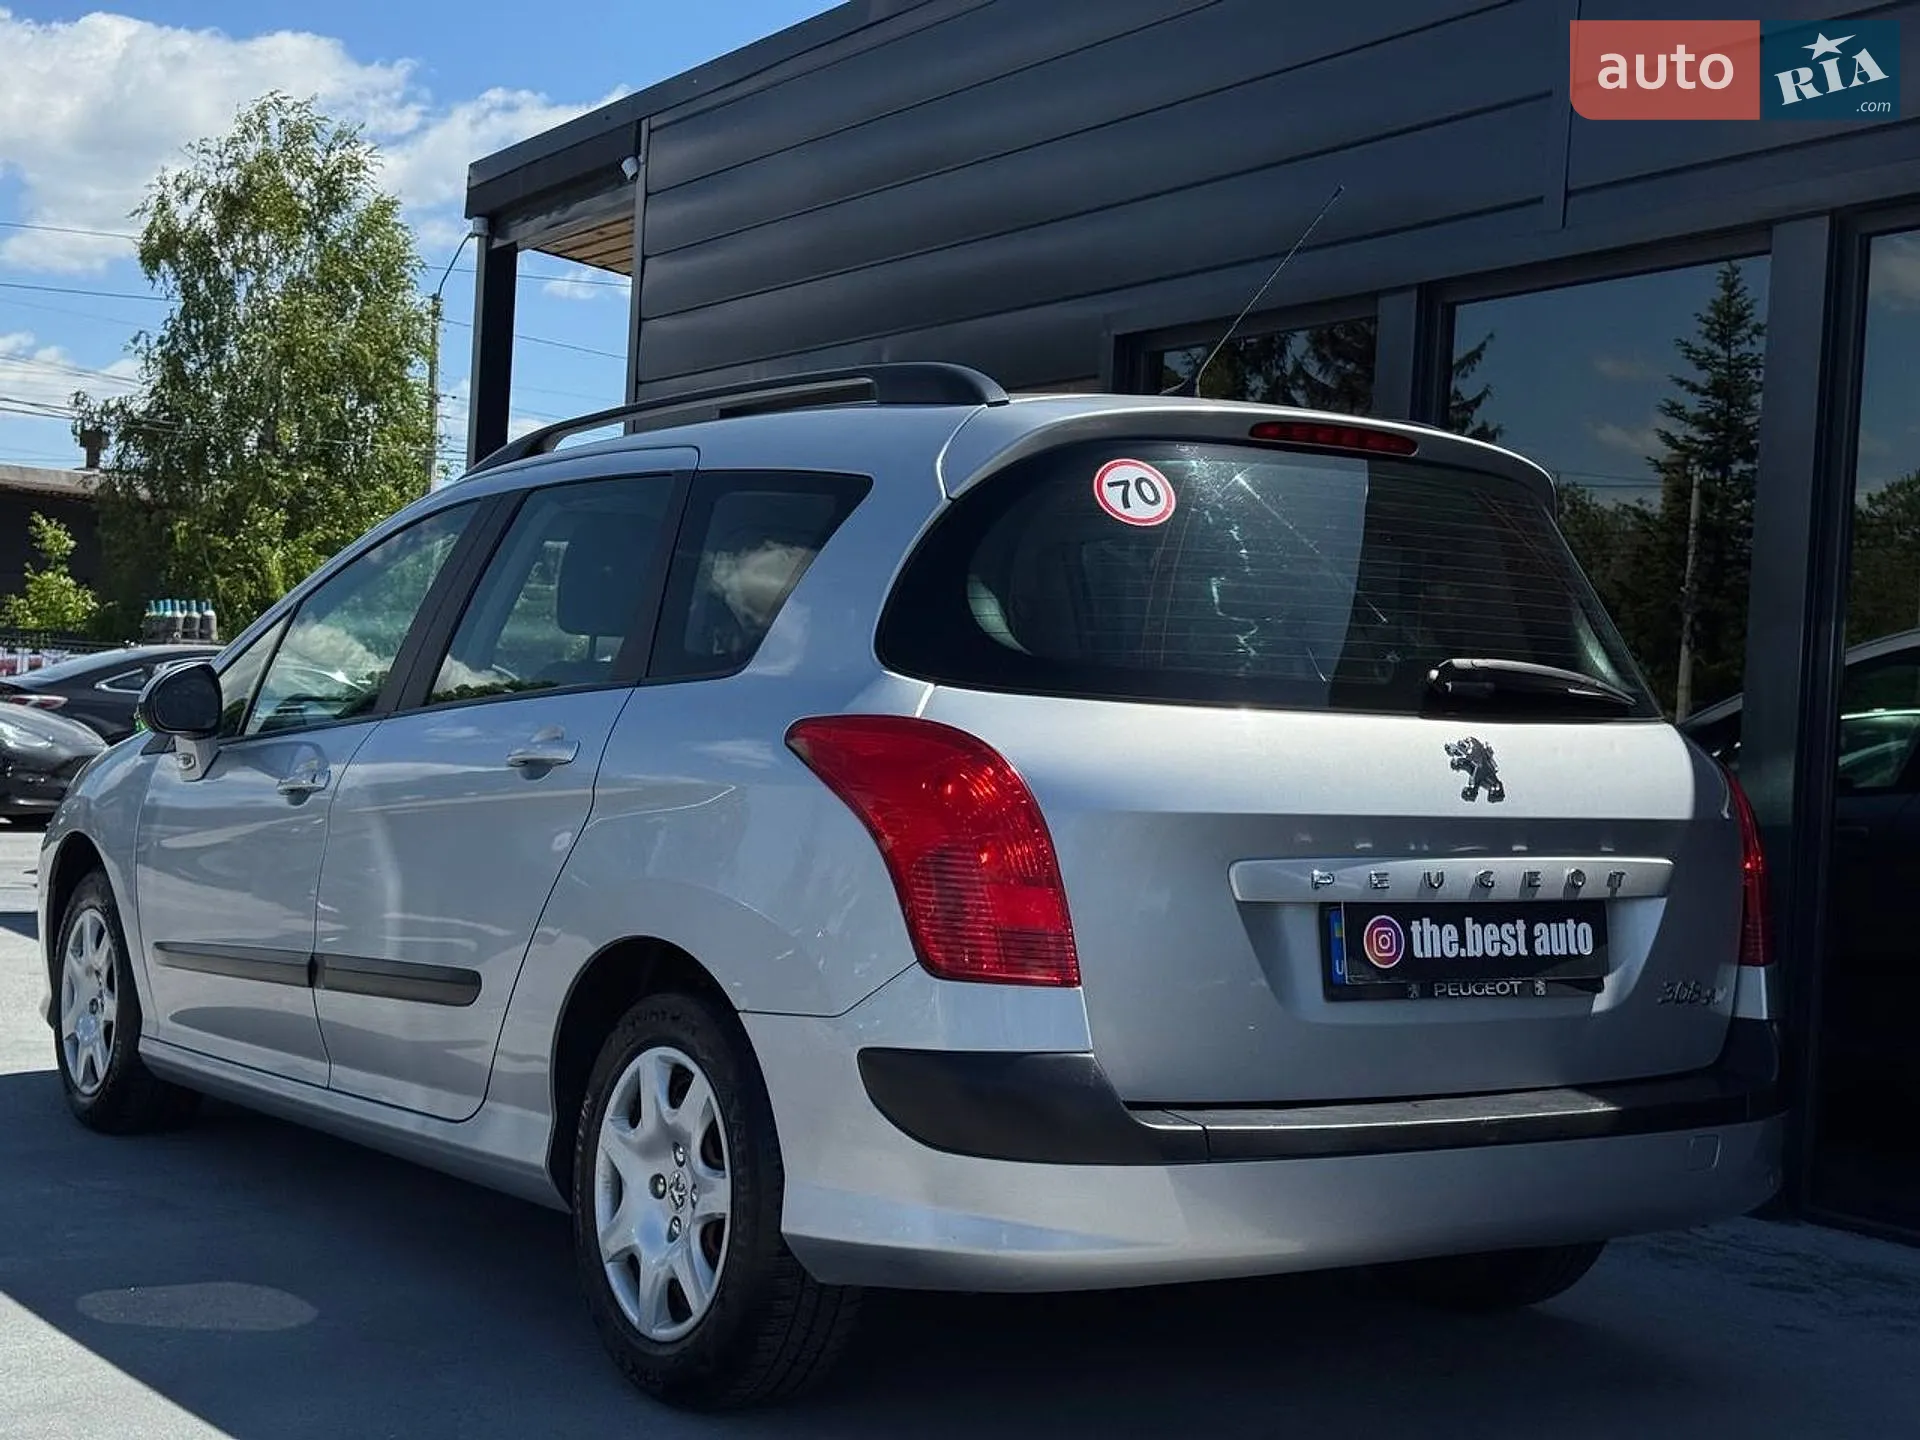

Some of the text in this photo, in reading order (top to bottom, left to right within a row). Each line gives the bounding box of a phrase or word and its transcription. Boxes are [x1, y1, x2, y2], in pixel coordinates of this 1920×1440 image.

[1107, 477, 1162, 509] 70
[1311, 869, 1626, 889] PEUGEOT
[1411, 917, 1593, 958] the.best auto
[1434, 980, 1522, 996] PEUGEOT
